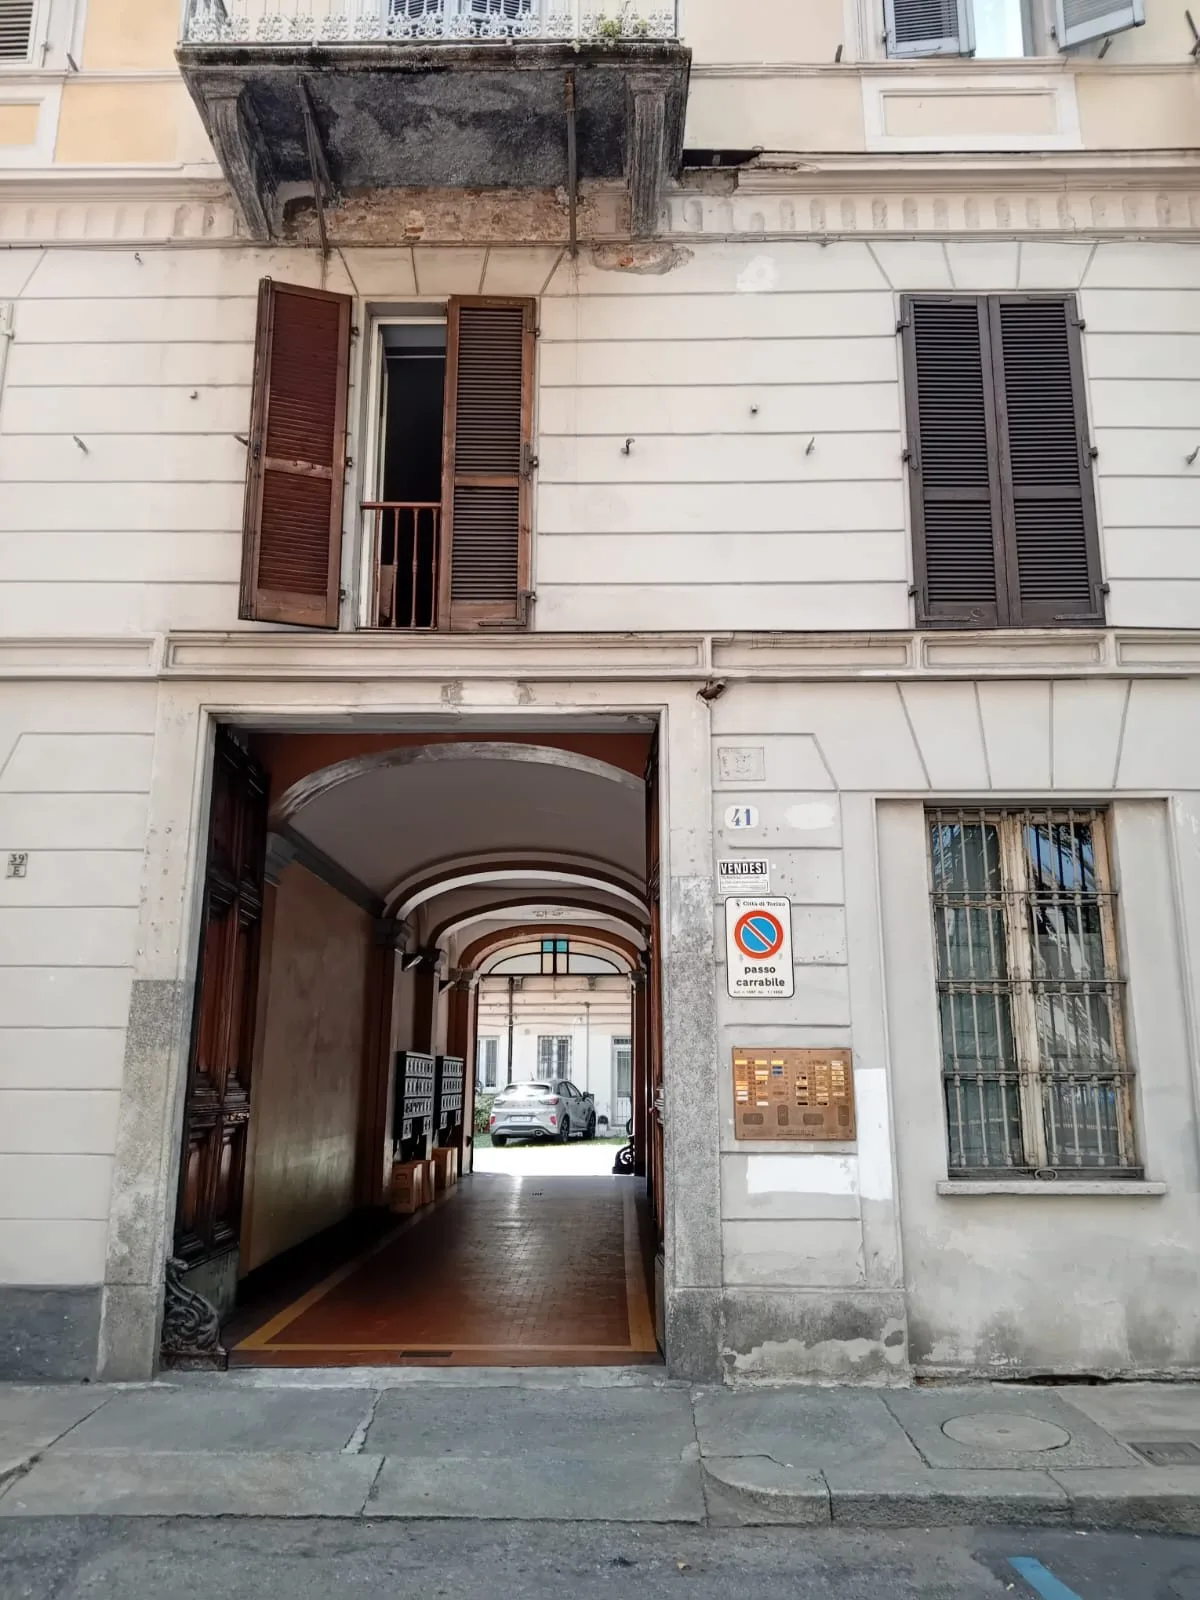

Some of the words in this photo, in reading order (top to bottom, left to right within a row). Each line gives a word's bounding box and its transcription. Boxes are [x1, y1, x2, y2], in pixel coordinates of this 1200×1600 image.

[731, 808, 751, 826] 41
[721, 862, 767, 874] VENDESI
[744, 966, 776, 975] passo
[736, 977, 785, 987] carrabile
